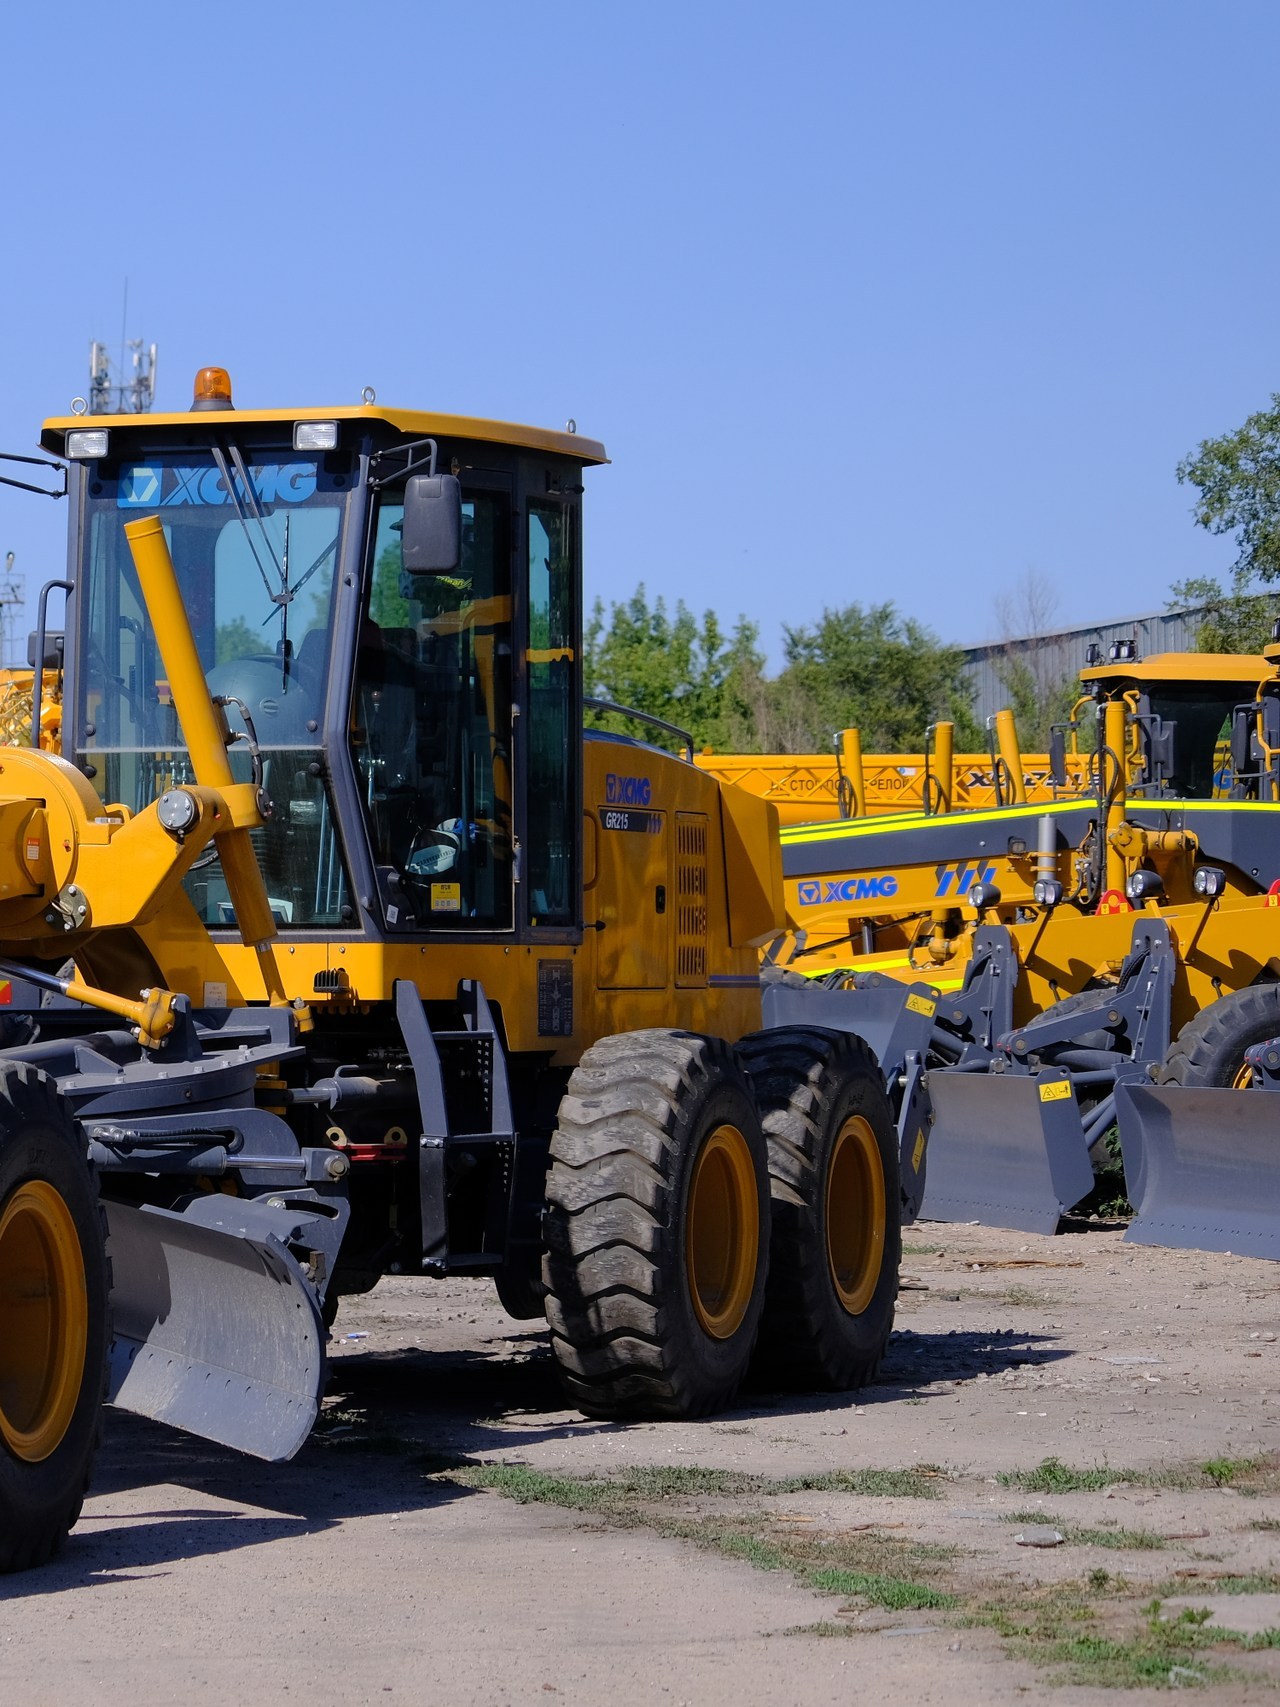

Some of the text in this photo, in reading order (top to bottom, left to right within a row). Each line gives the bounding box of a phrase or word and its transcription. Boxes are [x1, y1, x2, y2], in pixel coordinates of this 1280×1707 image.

[160, 462, 318, 505] XCMG
[617, 777, 651, 806] XCMG
[605, 812, 629, 830] GR215
[822, 875, 899, 903] XCMG
